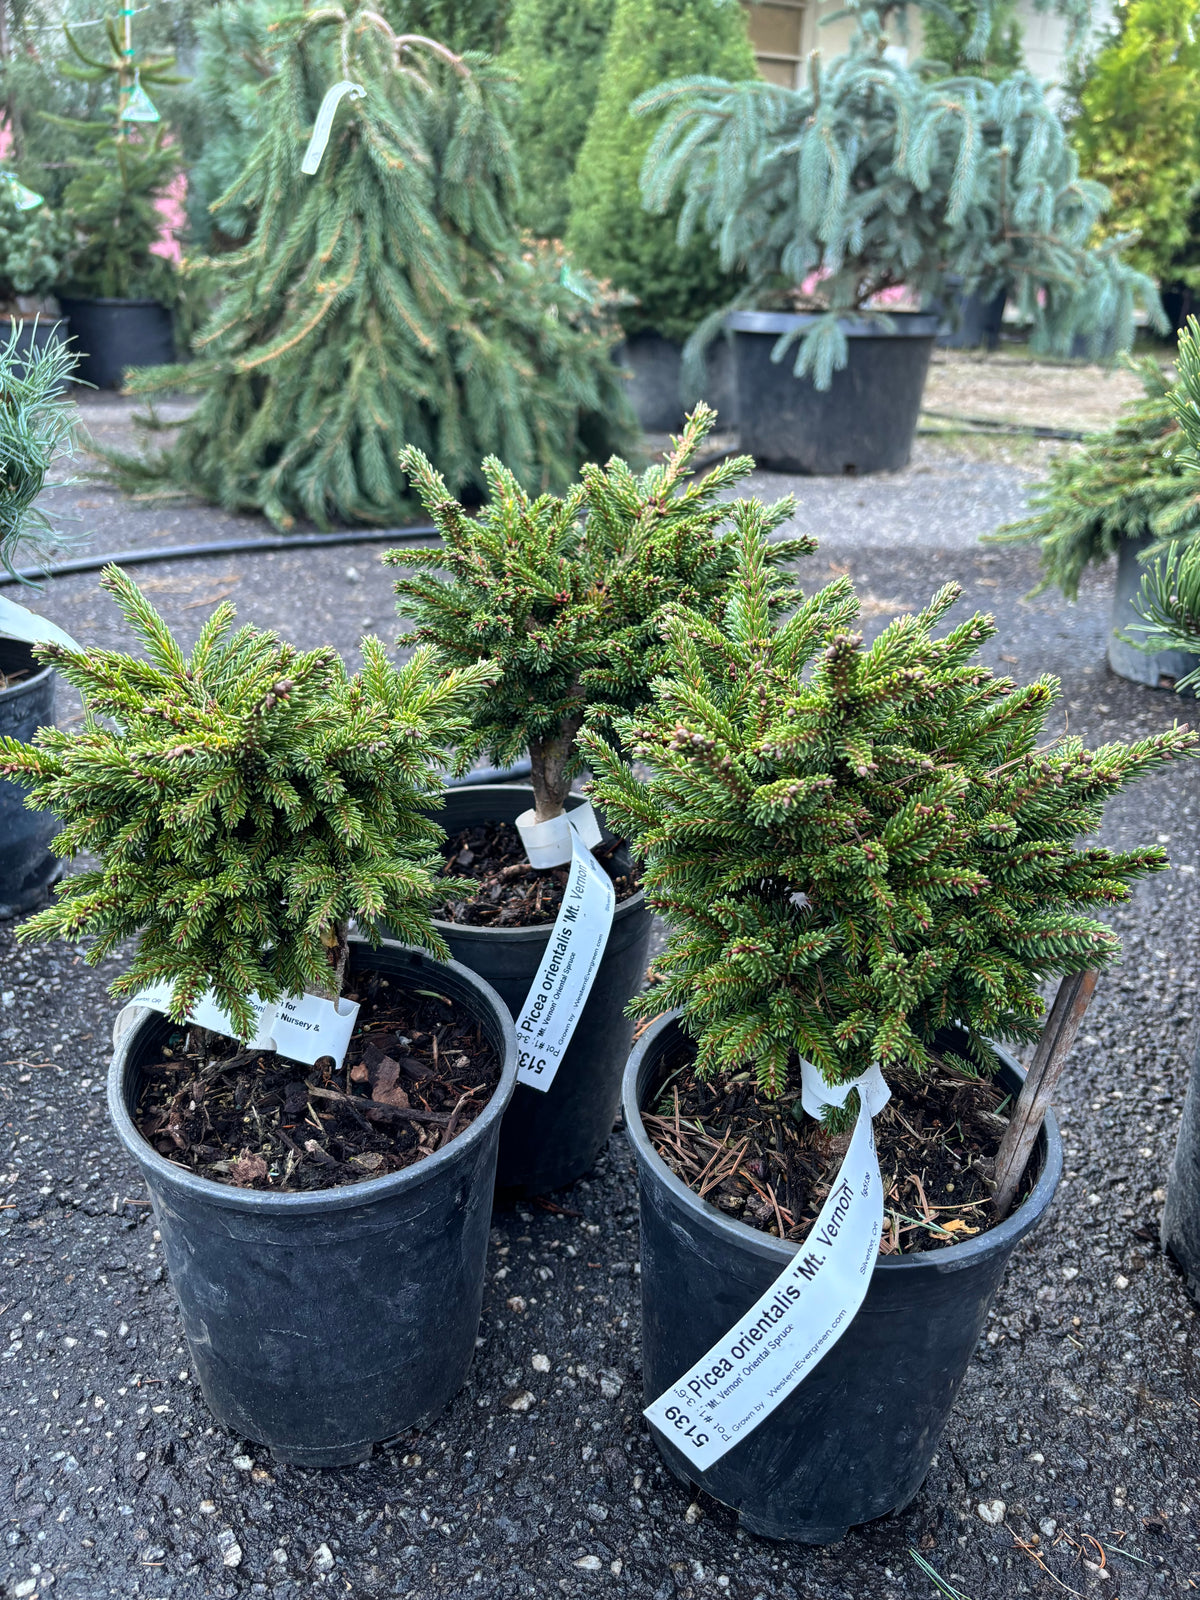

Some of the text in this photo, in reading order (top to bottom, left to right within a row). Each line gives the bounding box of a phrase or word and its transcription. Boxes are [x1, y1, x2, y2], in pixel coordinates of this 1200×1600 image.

[521, 860, 587, 1032] Picea orientalis 'Mt. Vernon'
[553, 974, 568, 1000] Oriental
[563, 951, 576, 974] Spruce
[280, 1012, 320, 1032] Nursery &
[285, 1001, 297, 1012] for
[558, 1023, 570, 1045] Grown
[567, 1013, 576, 1023] by
[518, 1049, 546, 1074] 513
[687, 1177, 854, 1398] Picea orientalis 'Mt. Vernon'
[717, 1373, 744, 1400] Vernon'
[742, 1347, 771, 1377] Oriental
[768, 1323, 794, 1350] Spruce
[731, 1309, 847, 1432] Grown by WesternEvergreen.com
[664, 1406, 709, 1447] 5139
[713, 1422, 732, 1442] Pot
